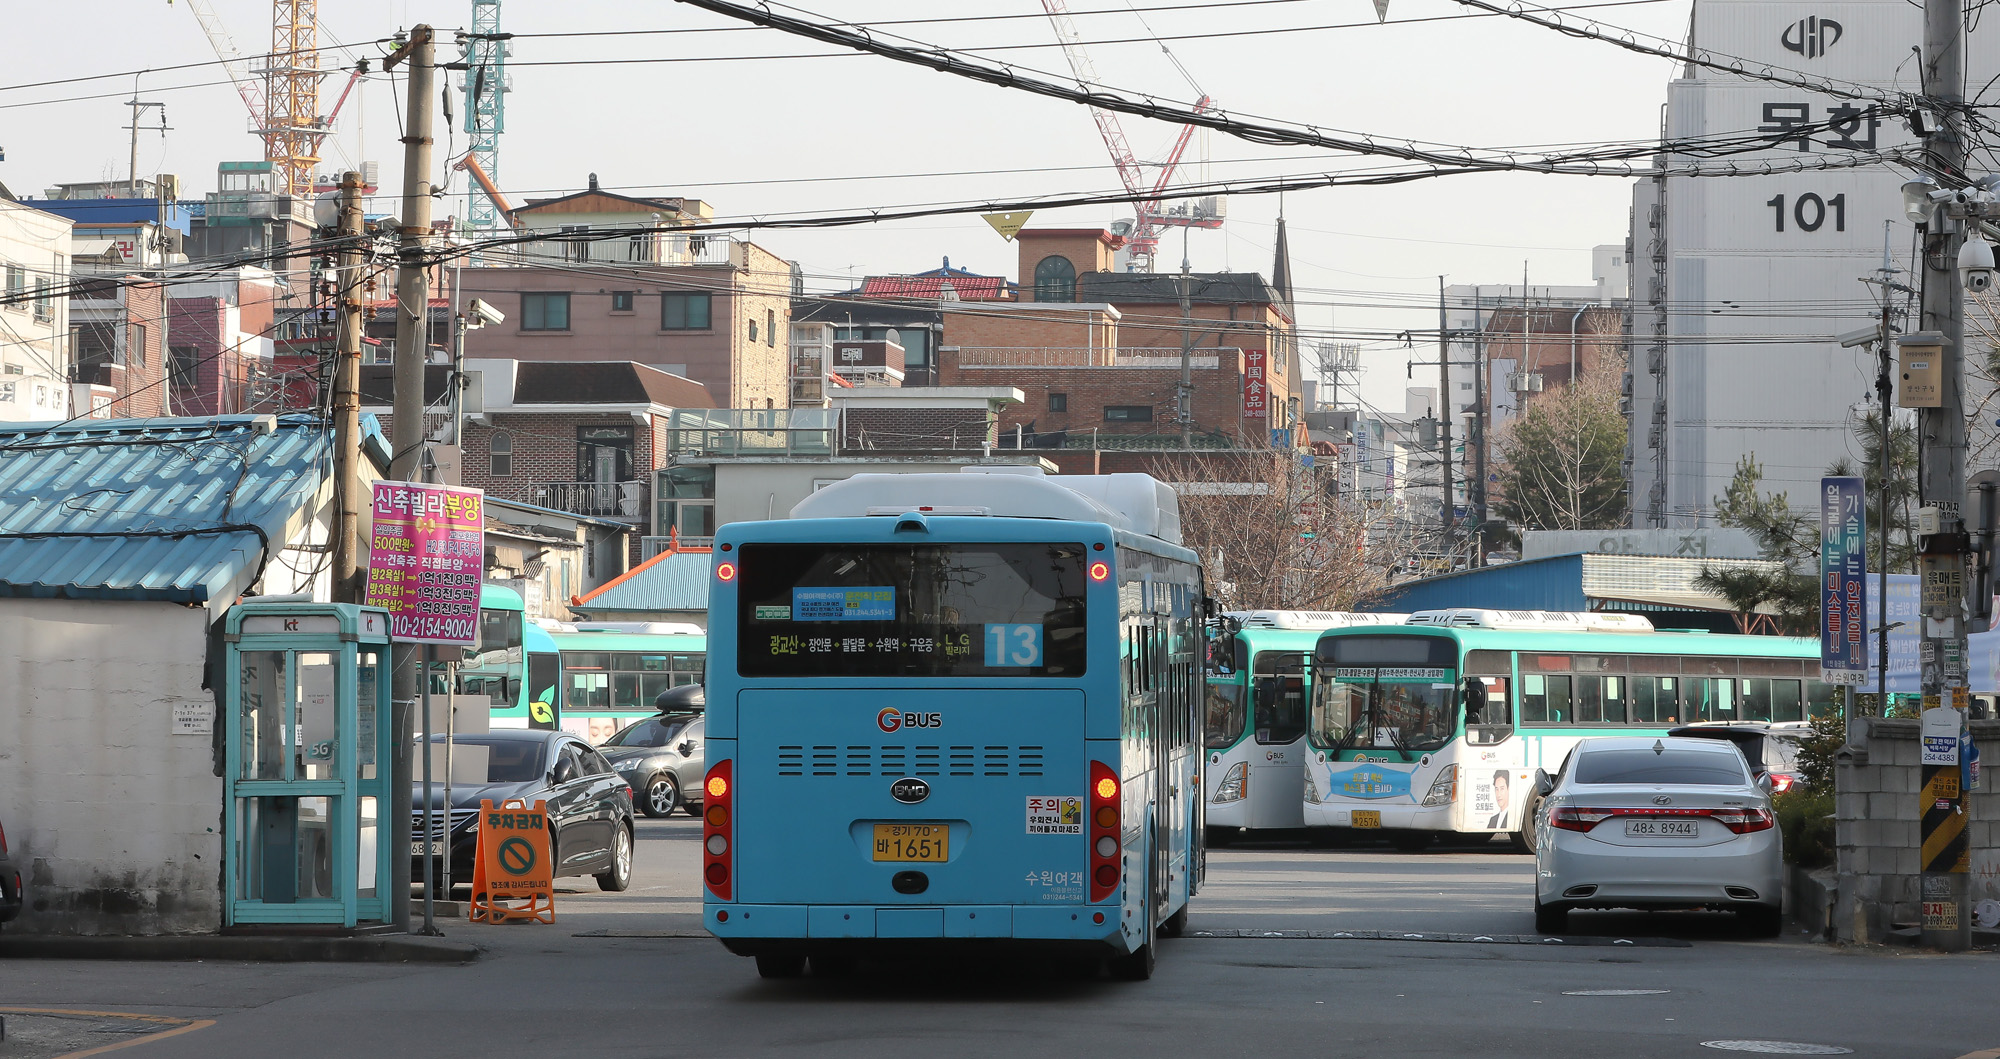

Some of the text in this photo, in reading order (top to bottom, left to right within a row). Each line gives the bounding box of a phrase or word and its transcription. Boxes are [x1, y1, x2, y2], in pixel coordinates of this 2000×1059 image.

[1757, 102, 1881, 152] 목화
[1766, 192, 1845, 232] 101
[1246, 351, 1265, 408] 中国食品
[375, 525, 404, 536] 실입주금
[1827, 485, 1841, 566] 얼굴에는
[449, 530, 480, 542] 교포환영
[387, 554, 464, 571] 건축주 직접분양
[371, 567, 405, 582] 방2욕실1
[1846, 494, 1861, 664] 가슴에는 안전을!!
[369, 582, 404, 597] 방3욕실1
[1827, 571, 1841, 653] 미소를!!
[284, 619, 299, 632] kt
[391, 614, 474, 639] 10-2154-9004
[770, 635, 799, 655] 광교산
[808, 637, 832, 651] 장안문
[842, 637, 866, 651] 팔달문
[876, 637, 900, 652] 수원역
[909, 637, 933, 652] 구운중
[945, 645, 970, 656] 빌리지
[989, 625, 1038, 666] 13
[1835, 672, 1865, 685] 수원여객
[311, 742, 329, 756] 5G
[1521, 736, 1542, 767] 11
[894, 785, 926, 796] BYD
[1029, 798, 1060, 814] 주의
[488, 813, 543, 830] 주차금지
[1360, 817, 1379, 827] 2576
[1632, 823, 1691, 834] 48소 8944
[892, 826, 930, 837] 경기 70
[411, 843, 437, 854] 682
[877, 839, 943, 859] 바 1651
[491, 880, 548, 889] 협조에 감사드립니다
[1025, 871, 1083, 887] 수원여객
